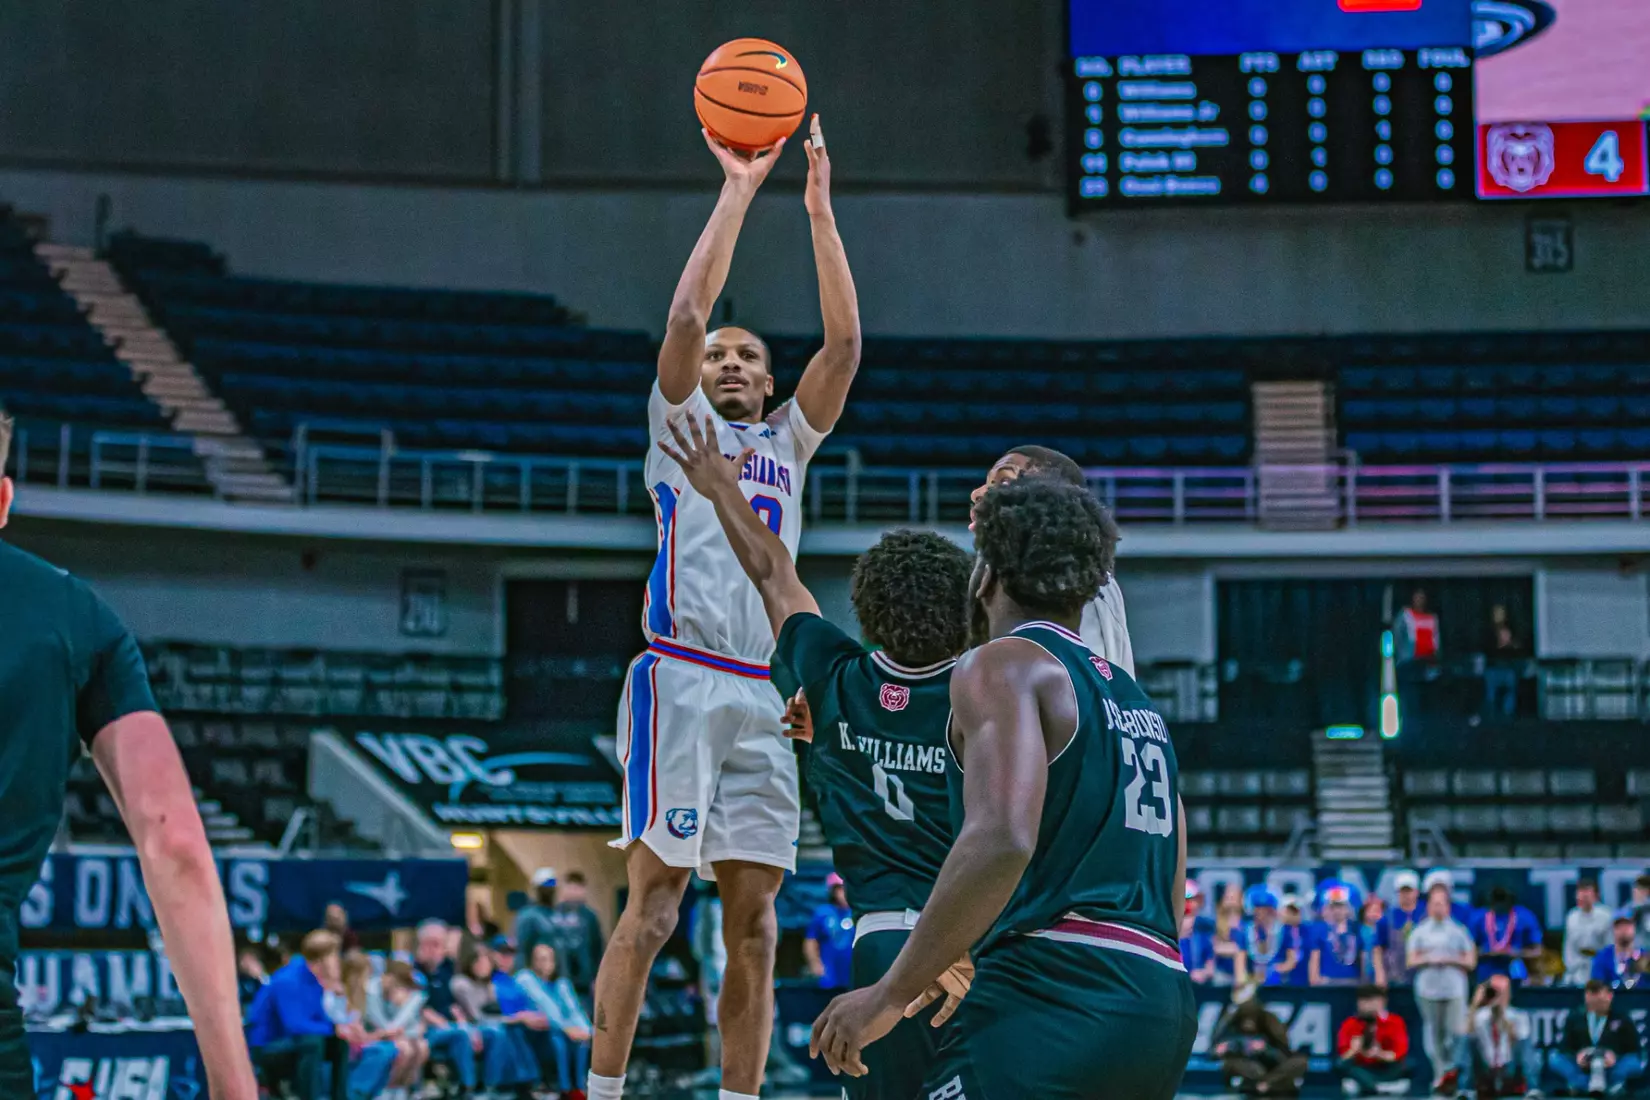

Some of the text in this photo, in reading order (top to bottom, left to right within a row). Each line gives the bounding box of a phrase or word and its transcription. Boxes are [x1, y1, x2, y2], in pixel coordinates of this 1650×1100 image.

[1585, 131, 1624, 182] 4
[354, 730, 516, 787] VBC
[838, 721, 946, 774] K. WILLIAMS
[871, 762, 915, 820] 0
[1121, 736, 1173, 838] 23
[229, 860, 269, 930] S
